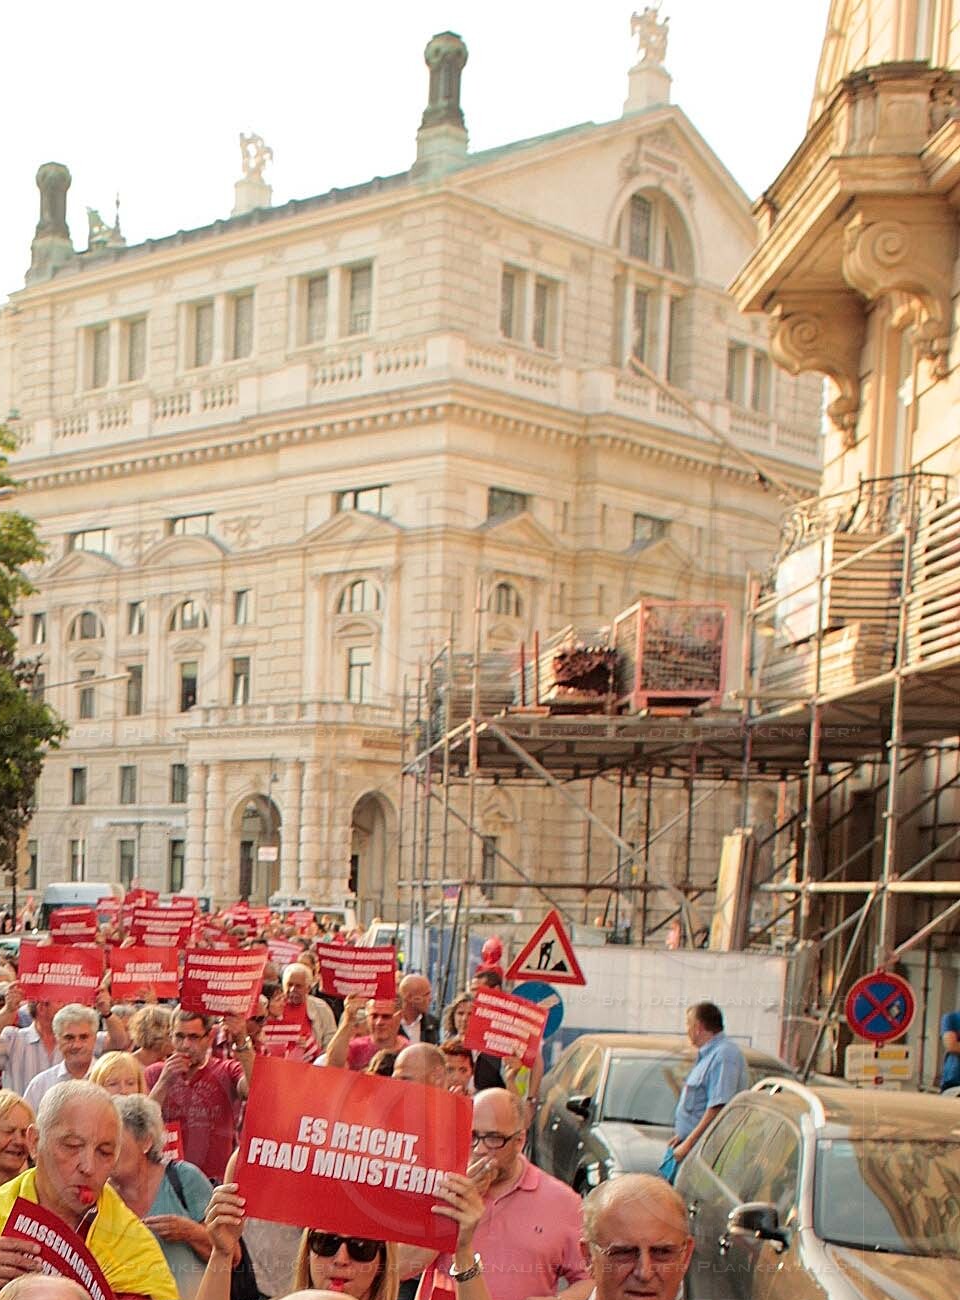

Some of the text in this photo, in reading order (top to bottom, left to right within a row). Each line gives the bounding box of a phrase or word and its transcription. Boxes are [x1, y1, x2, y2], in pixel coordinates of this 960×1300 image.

[247, 1137, 310, 1173] FRAU
[297, 1115, 419, 1164] ES REICHT,
[13, 1214, 94, 1289] MASSENLAGER
